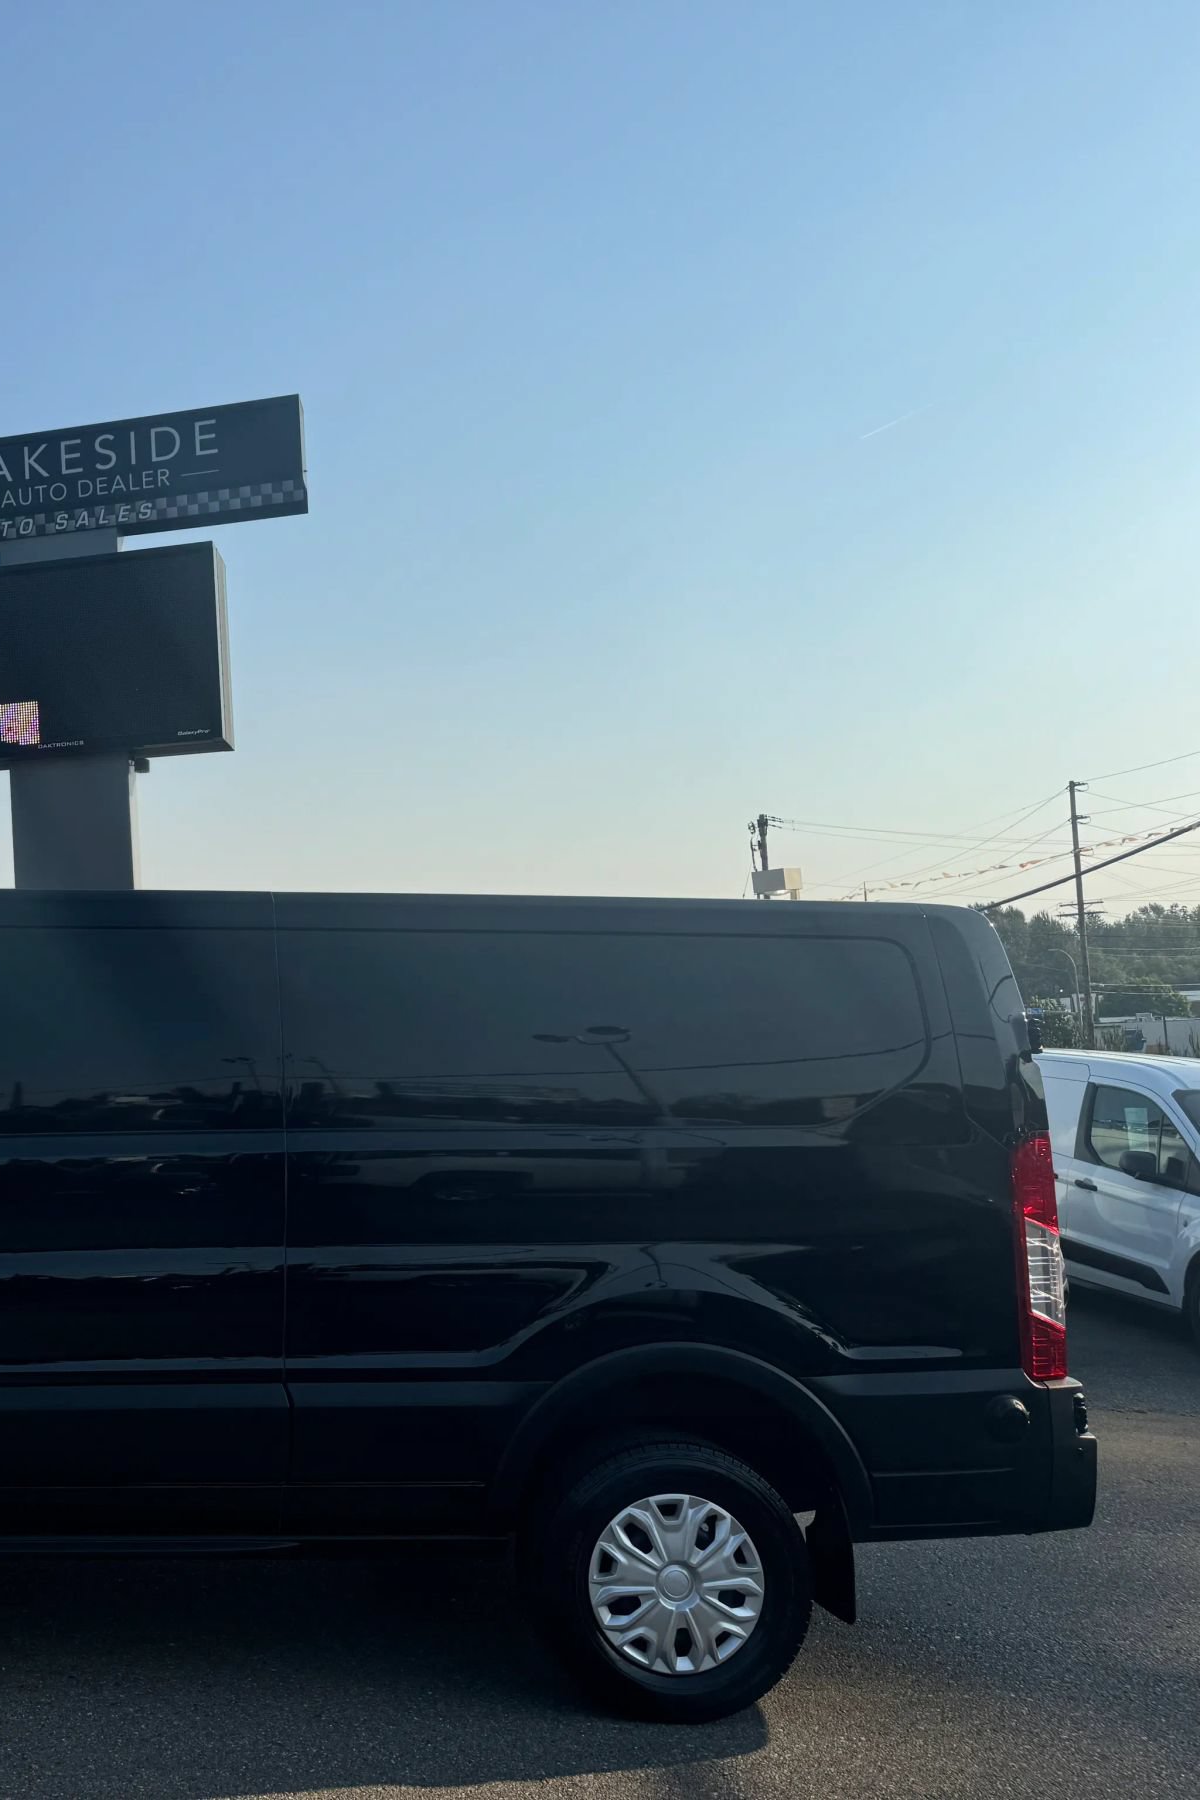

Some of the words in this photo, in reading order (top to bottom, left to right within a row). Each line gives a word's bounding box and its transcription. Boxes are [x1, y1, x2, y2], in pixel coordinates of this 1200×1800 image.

[0, 482, 68, 509] AUTO
[77, 468, 171, 498] DEALER
[55, 502, 153, 531] SALES
[37, 740, 85, 749] DAKTRONICS
